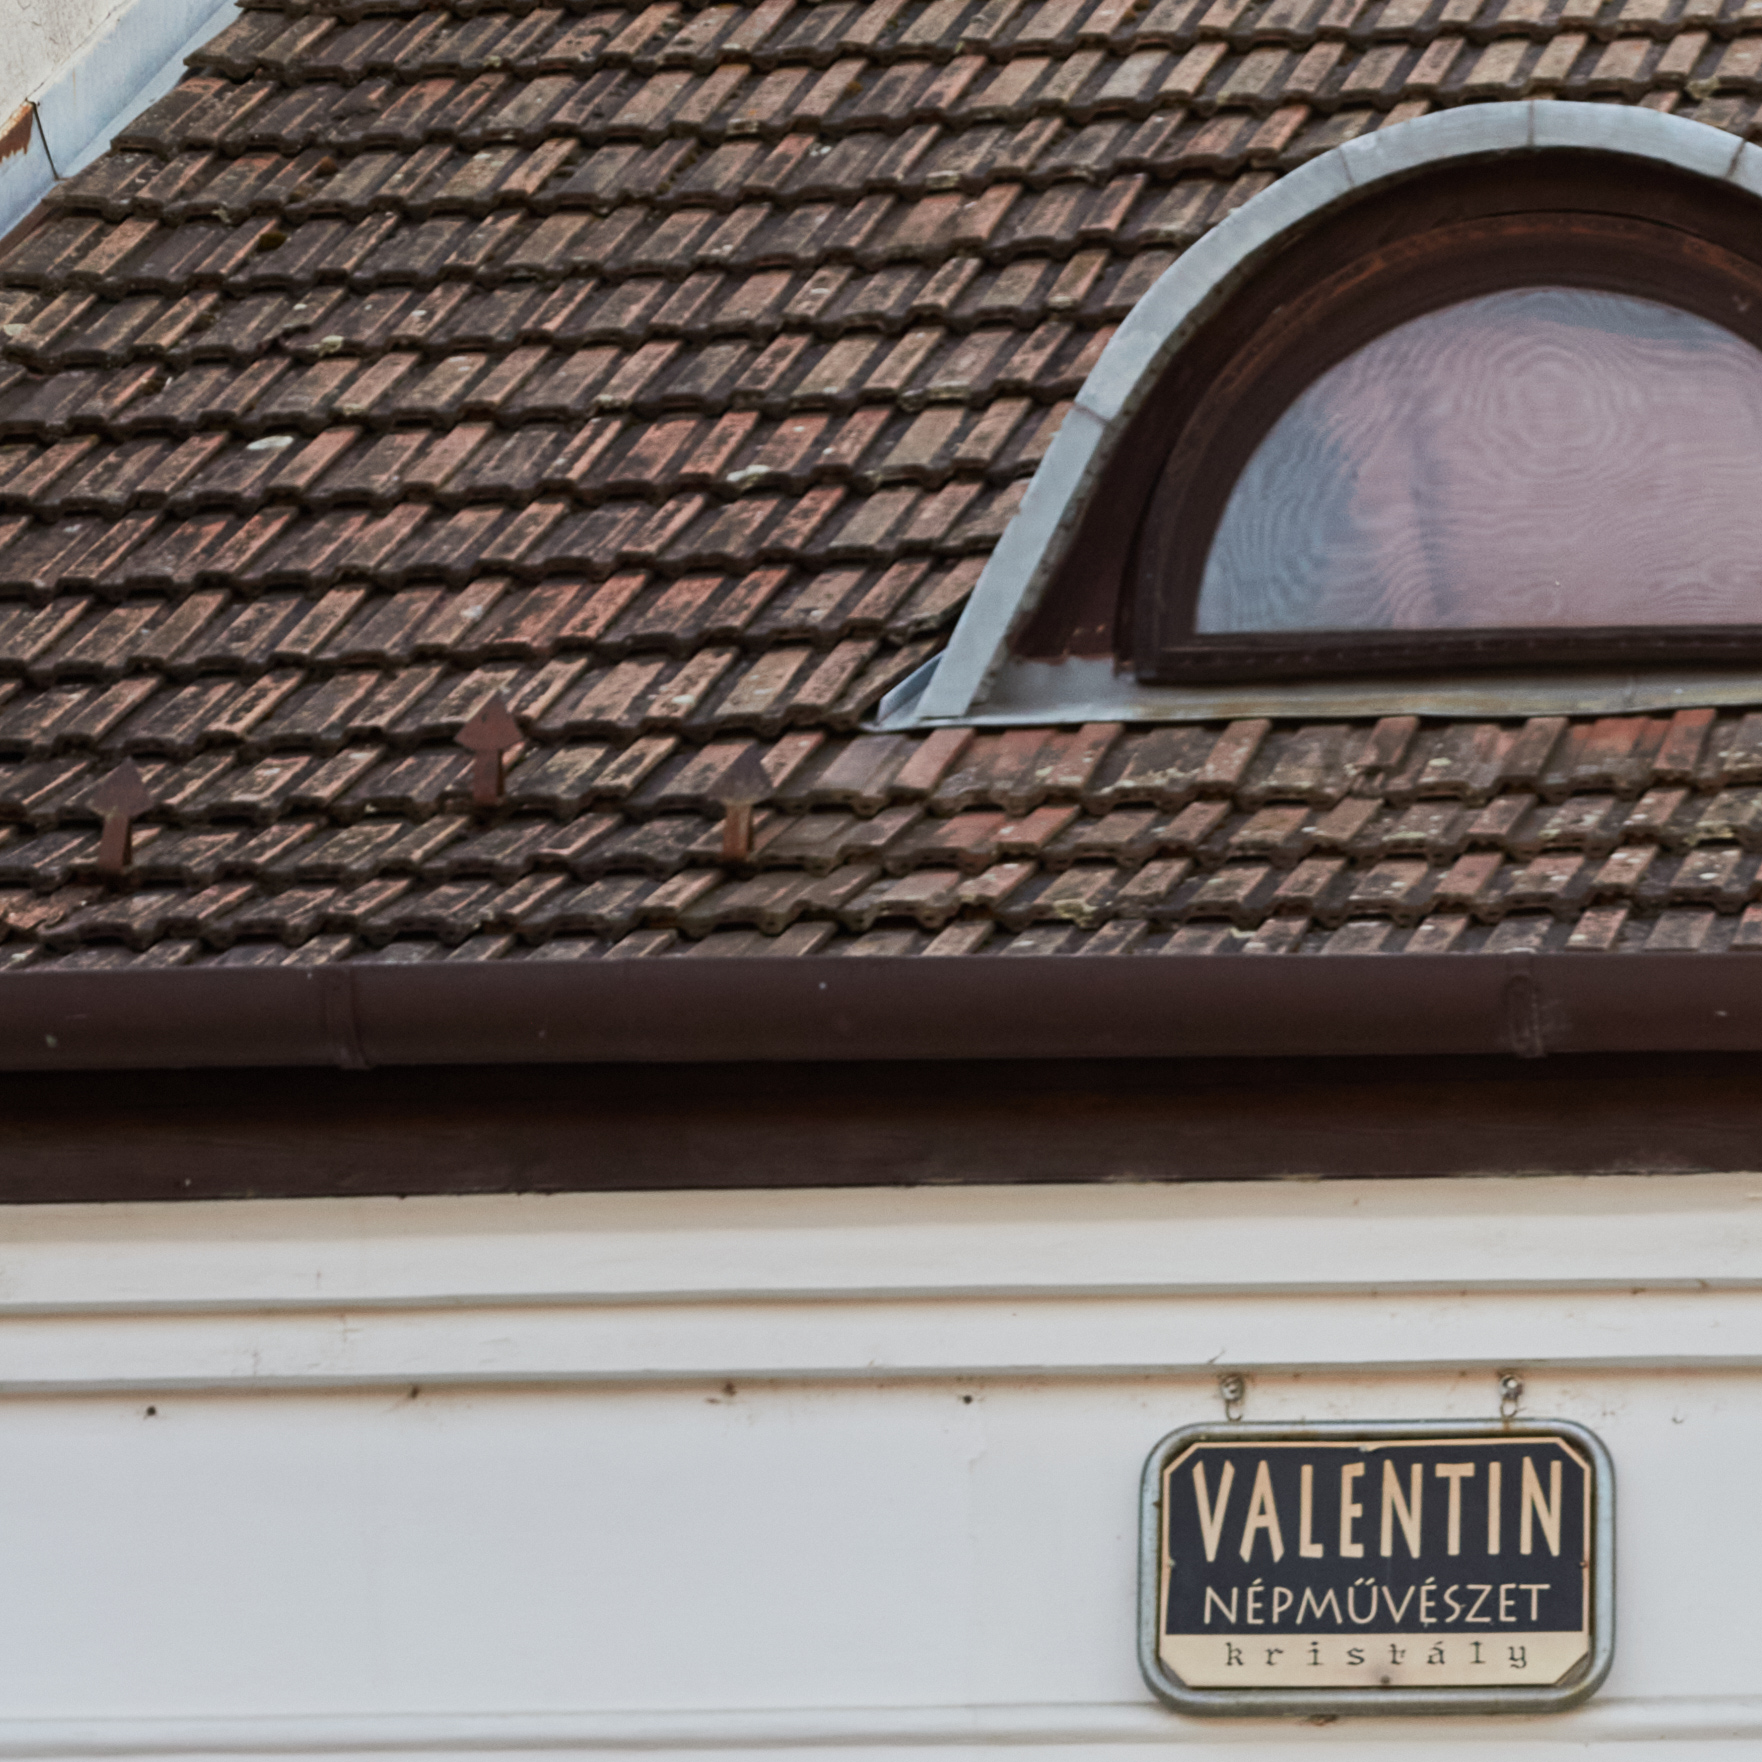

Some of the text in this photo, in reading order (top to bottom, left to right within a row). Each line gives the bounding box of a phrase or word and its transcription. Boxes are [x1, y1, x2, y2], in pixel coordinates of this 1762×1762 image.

[1193, 1456, 1562, 1563] VALENTIN
[1203, 1576, 1551, 1625] NÉPMŰVÉSZET
[1224, 1641, 1529, 1669] kristály
